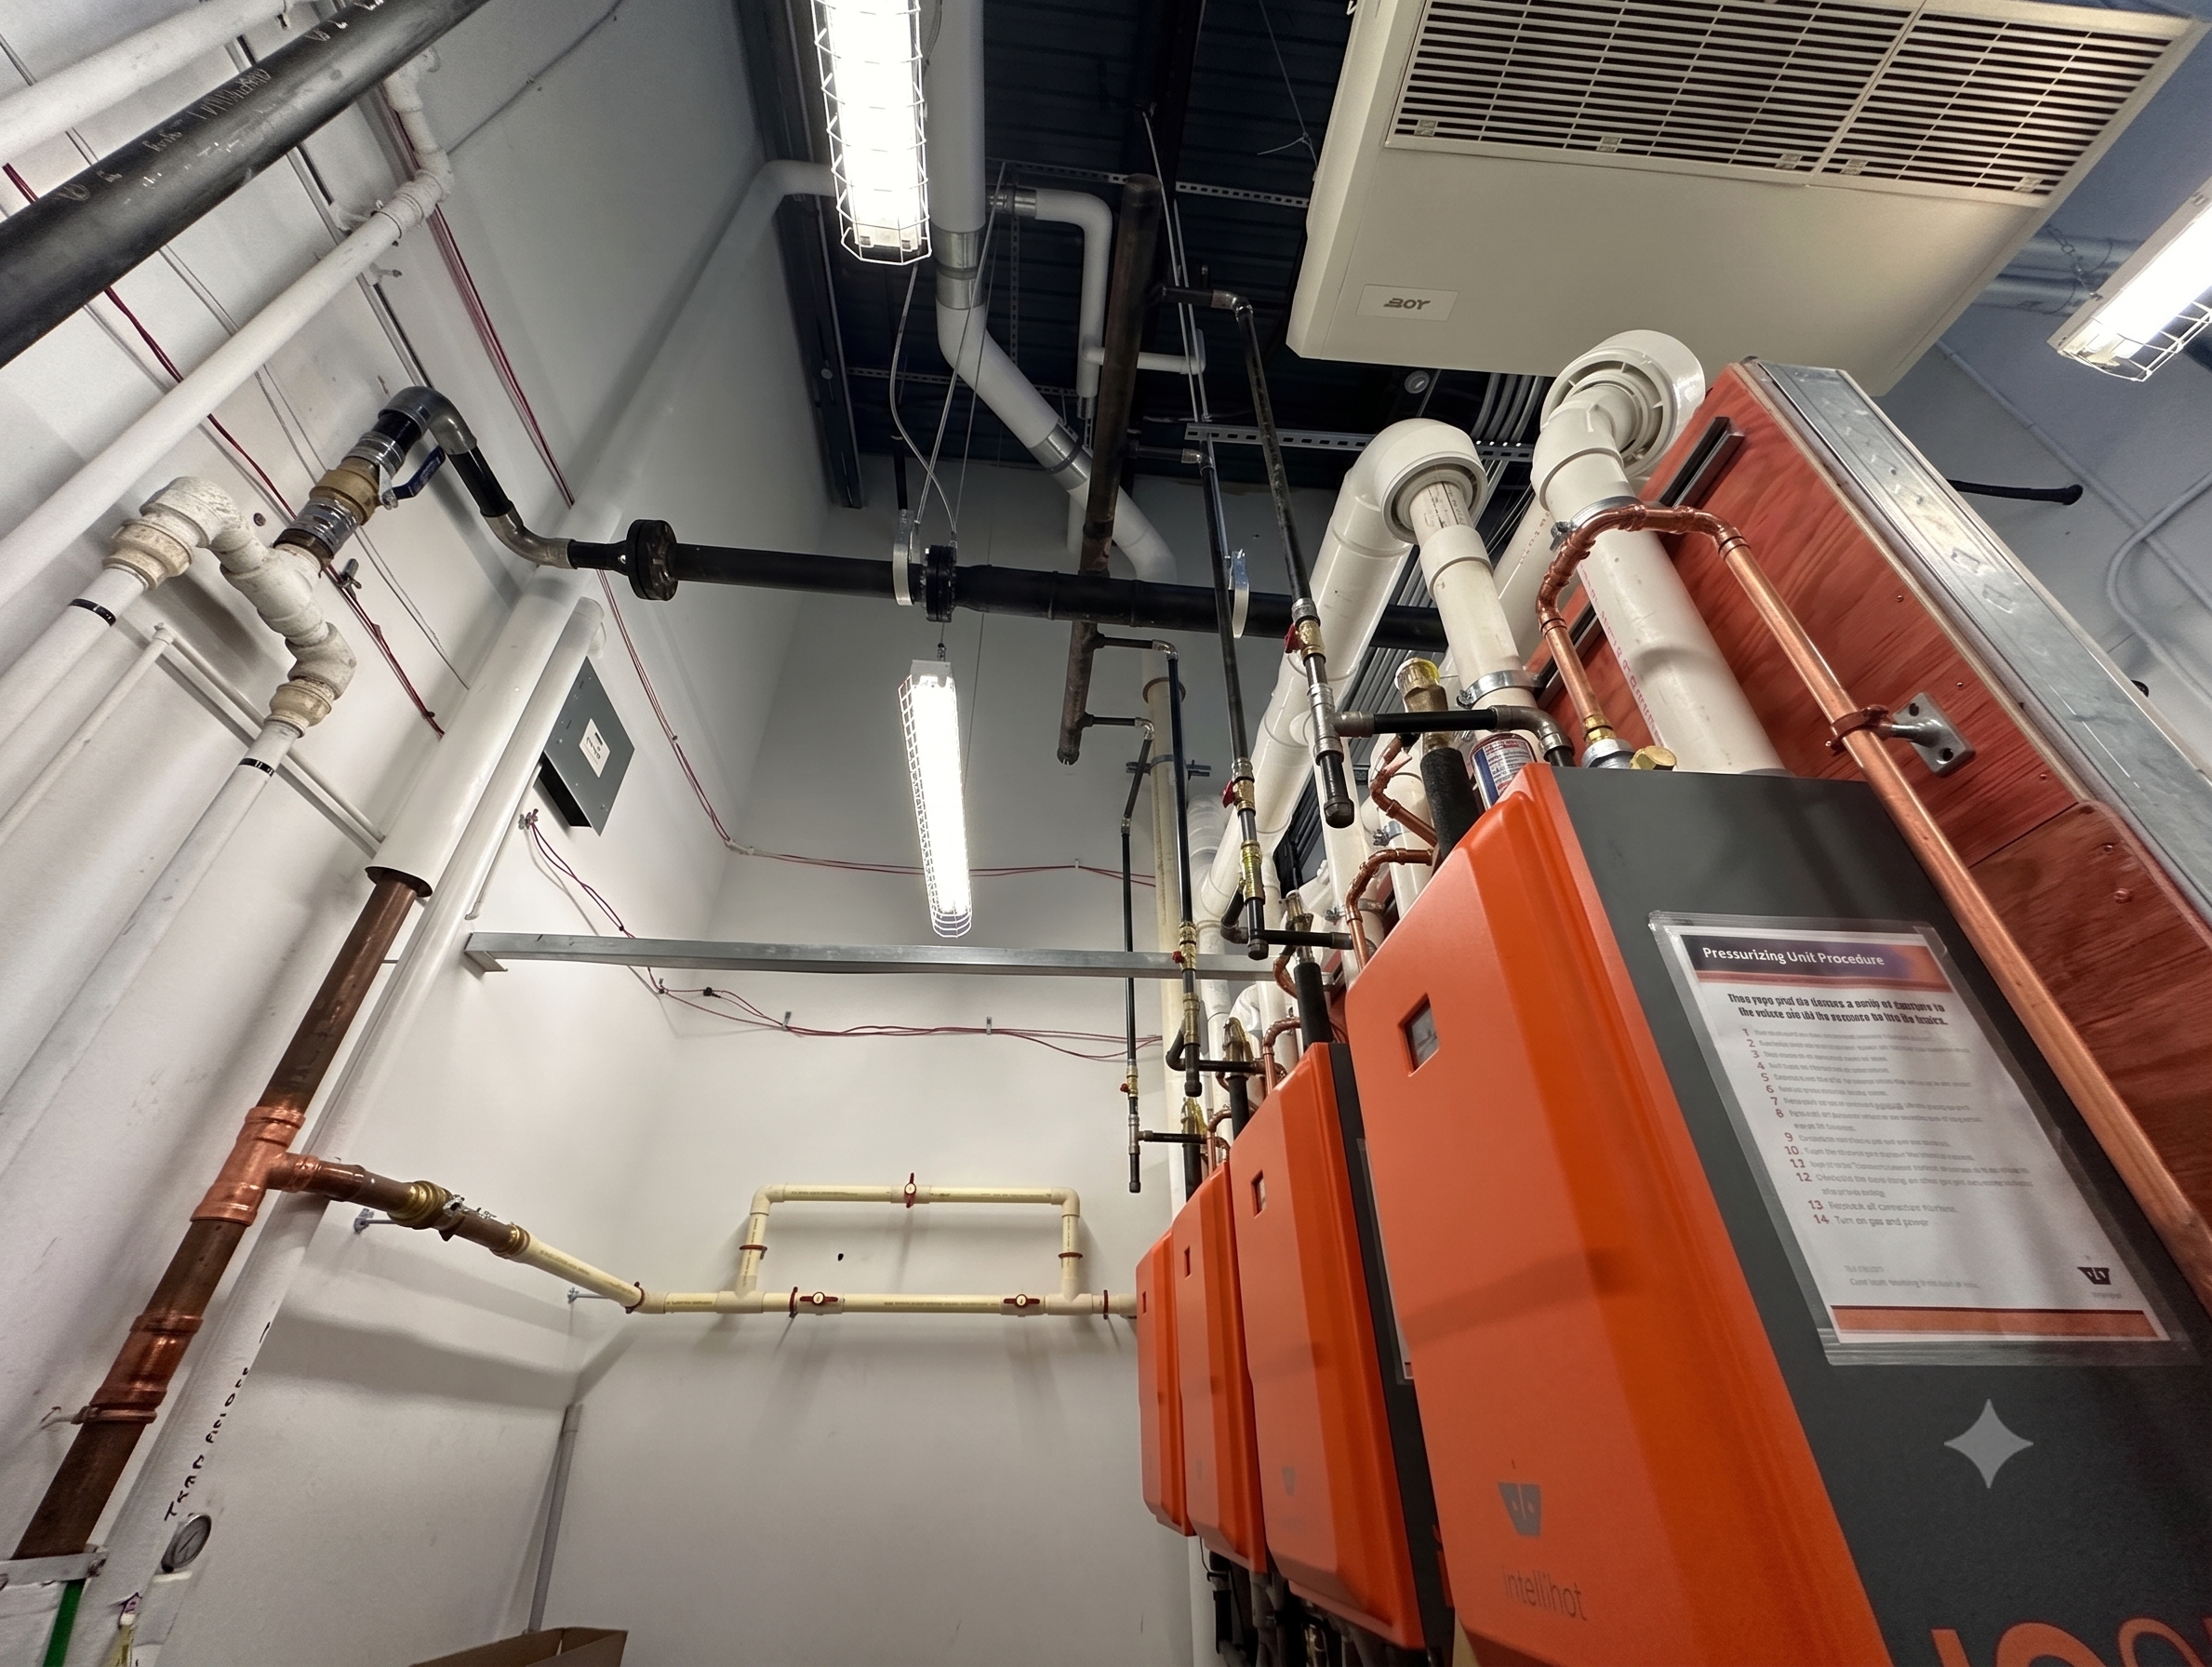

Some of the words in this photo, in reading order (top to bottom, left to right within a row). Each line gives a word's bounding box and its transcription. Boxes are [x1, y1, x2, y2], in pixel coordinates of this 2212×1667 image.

[1702, 947, 1787, 965] Pressurizing
[1786, 952, 1817, 964] Unit
[1818, 953, 1886, 966] Procedure
